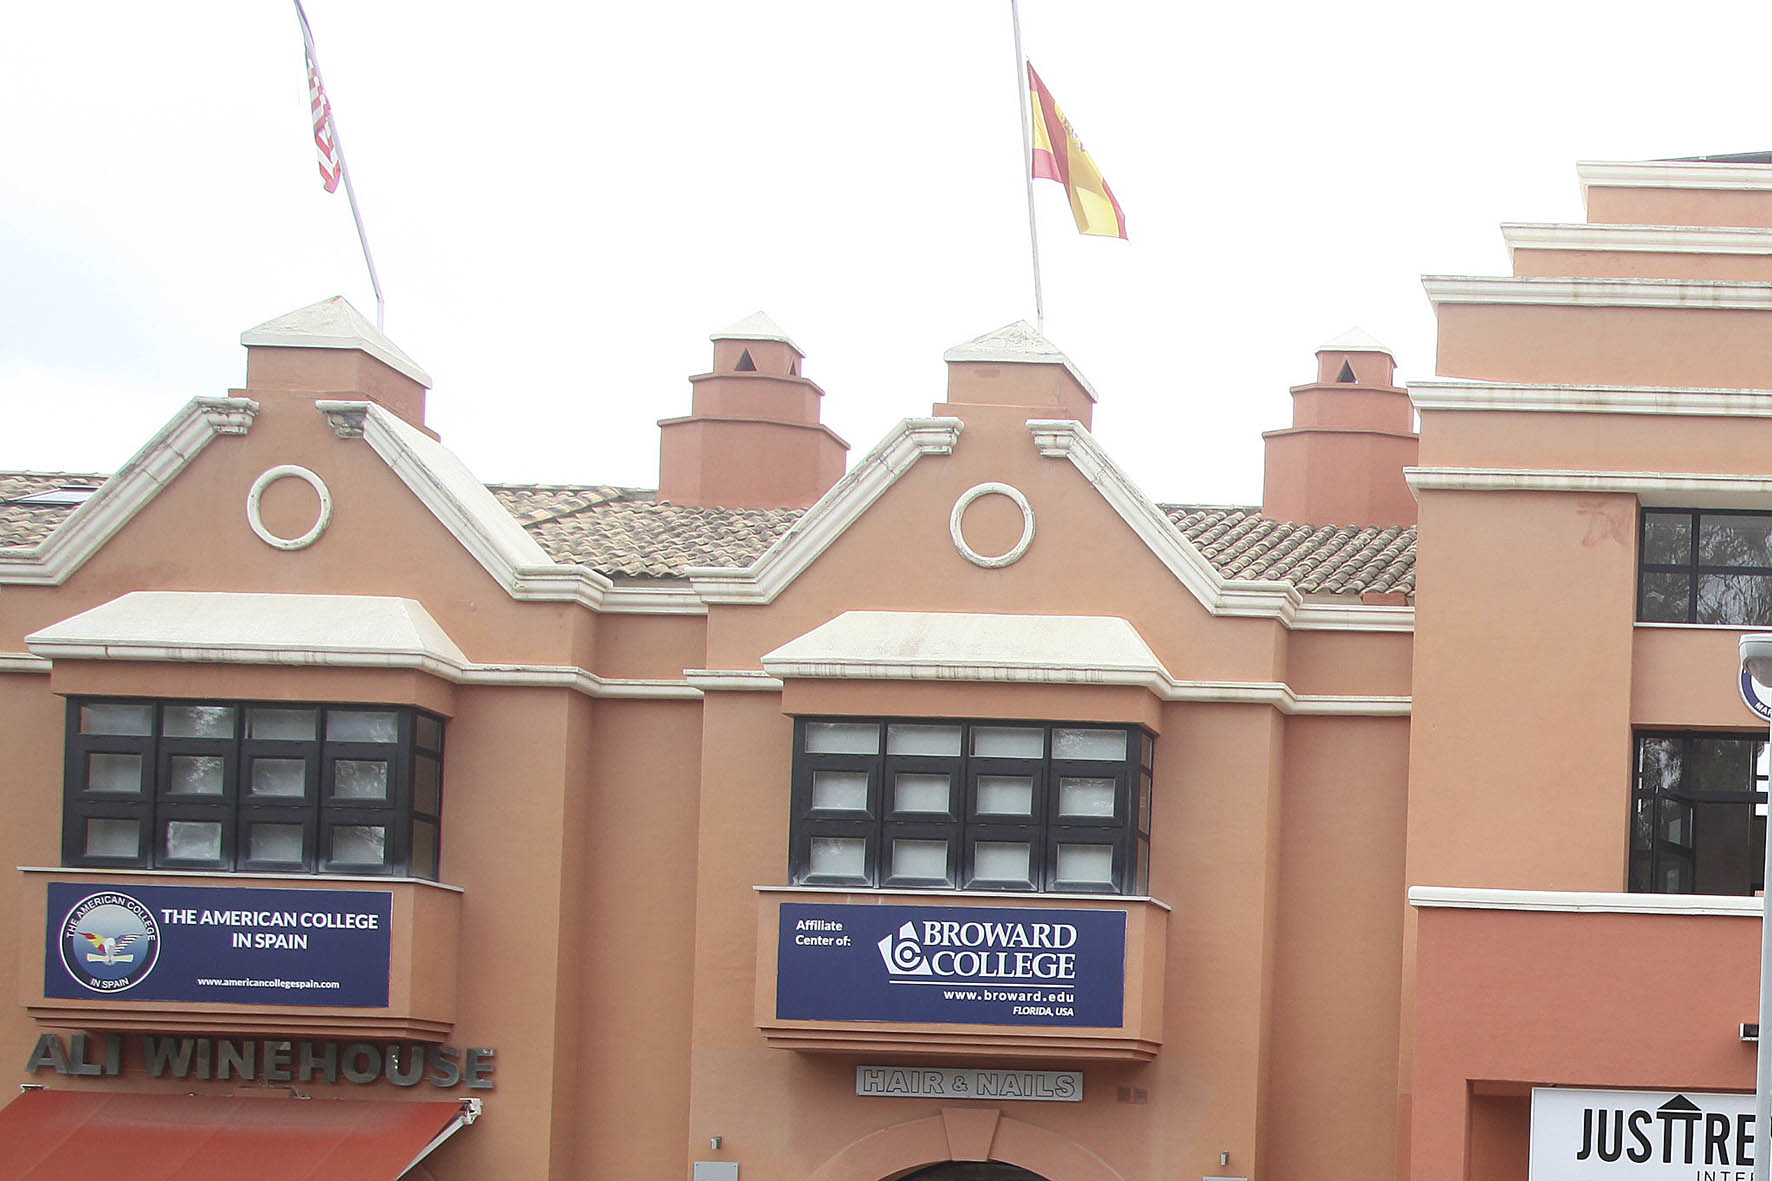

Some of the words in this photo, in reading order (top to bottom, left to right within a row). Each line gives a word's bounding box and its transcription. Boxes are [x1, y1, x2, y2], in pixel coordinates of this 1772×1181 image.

[66, 918, 78, 938] THE
[77, 895, 126, 919] AMERICAN
[127, 901, 156, 942] COLLEGE
[161, 908, 197, 925] THE
[199, 910, 297, 928] AMERICAN
[300, 911, 379, 930] COLLEGE
[795, 919, 843, 931] Affiliate
[232, 932, 252, 949] IN
[255, 933, 308, 950] SPAIN
[795, 934, 834, 946] Center
[835, 935, 852, 946] of:
[922, 919, 1078, 950] BROWARD
[931, 950, 1076, 980] COLLEGE
[90, 977, 100, 987] IN
[101, 977, 130, 989] SPAIN
[197, 977, 340, 990] www.americancollegespain.com
[943, 989, 1075, 1003] www.broward.edu
[1012, 1005, 1054, 1017] FLORIDA,
[1055, 1006, 1075, 1017] USA
[25, 1032, 121, 1077] ALI
[142, 1036, 495, 1090] WINEHOUSE
[863, 1069, 945, 1094] HAIR
[951, 1075, 969, 1093] &
[976, 1072, 1076, 1098] NAILS
